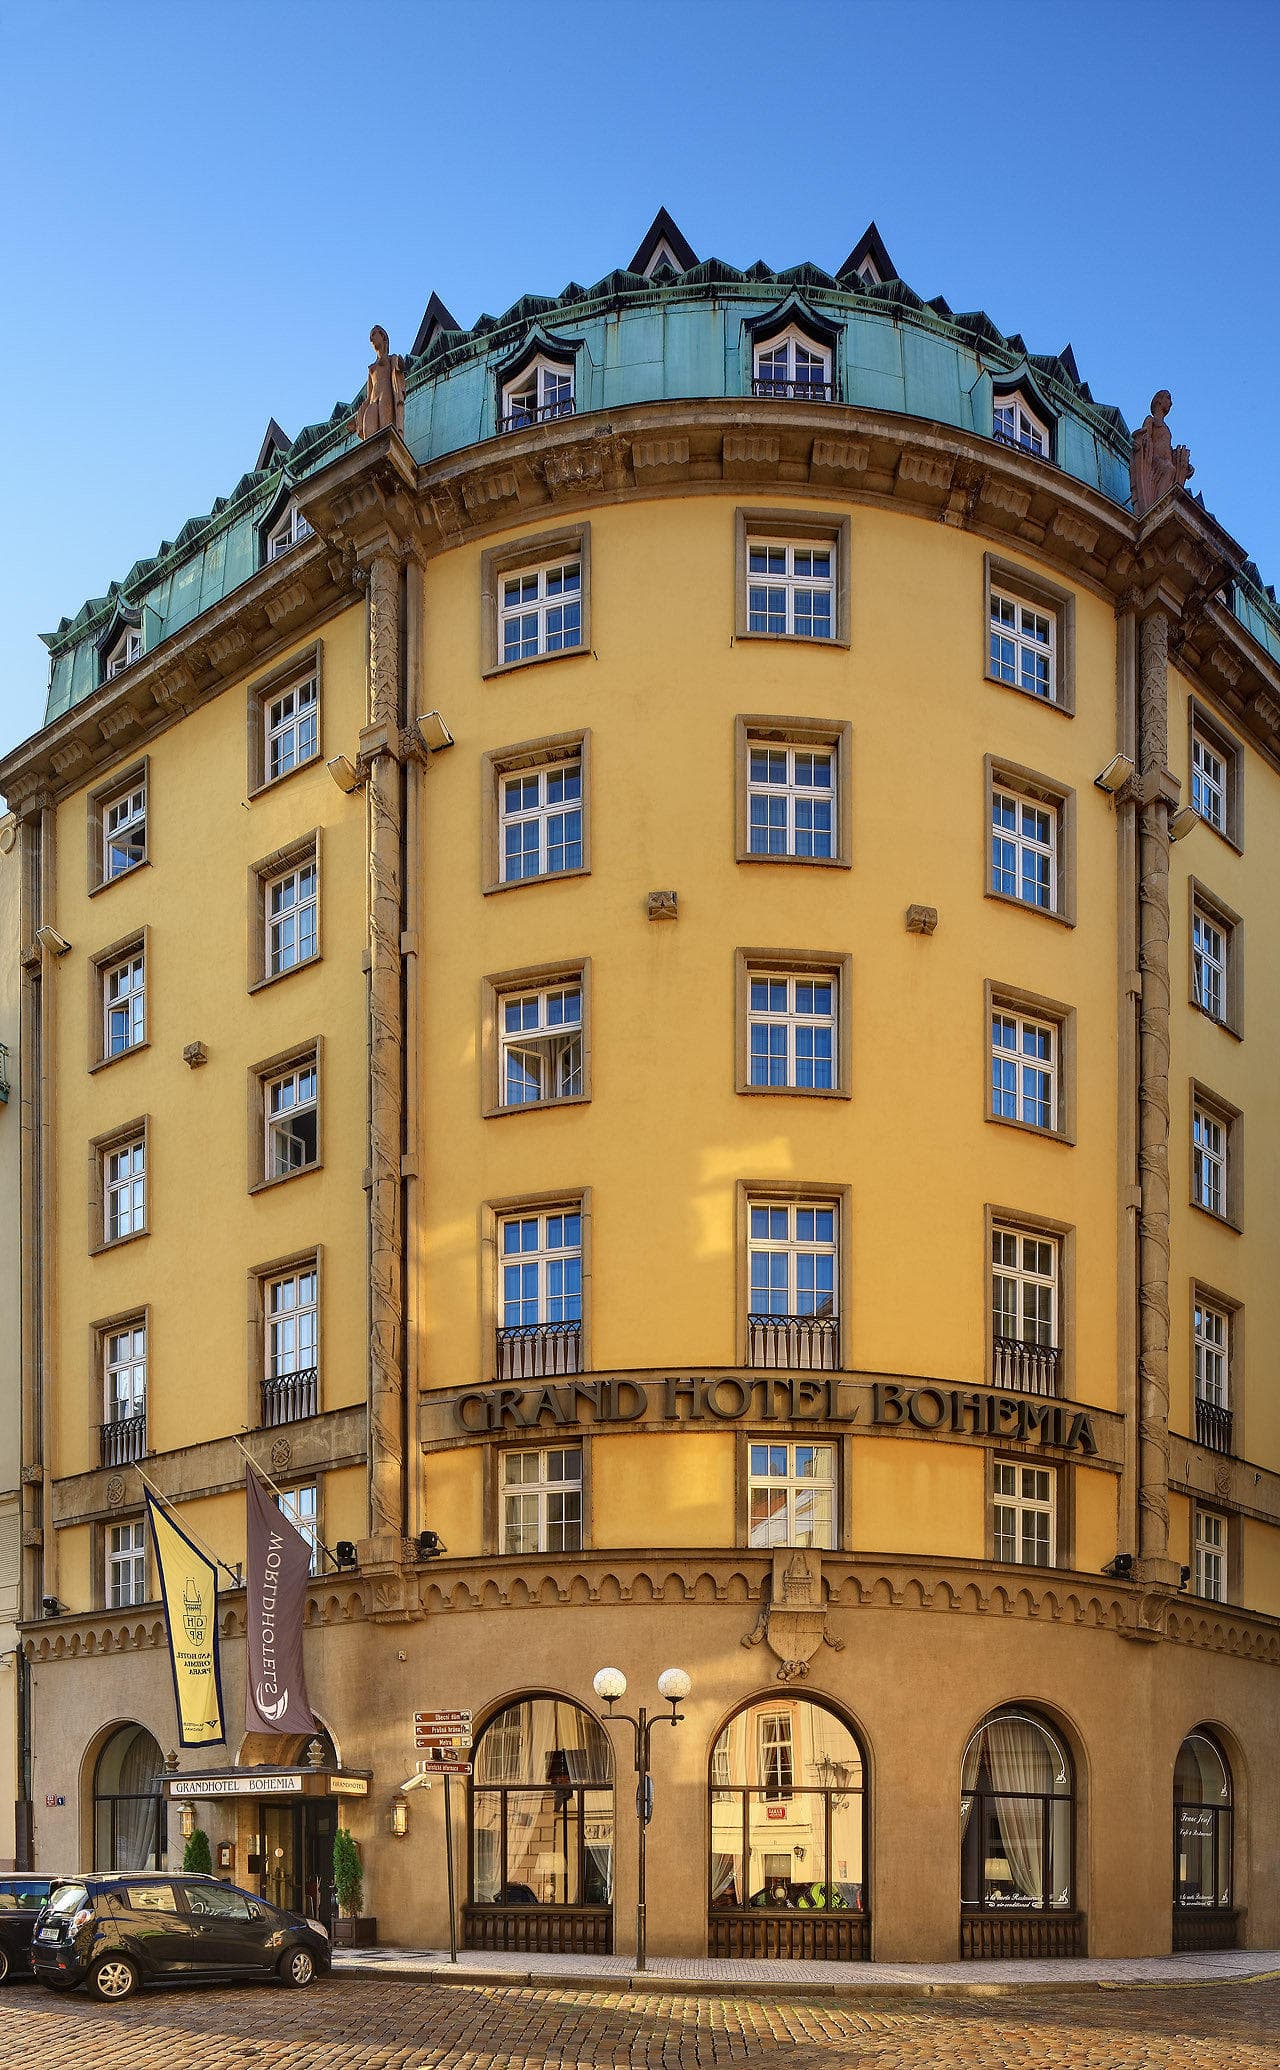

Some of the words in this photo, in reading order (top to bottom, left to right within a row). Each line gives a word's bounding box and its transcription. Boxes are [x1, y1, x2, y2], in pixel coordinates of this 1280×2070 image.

[452, 1378, 648, 1432] GRAND
[664, 1376, 860, 1424] HOTEL
[872, 1382, 1099, 1455] BOHEMIA
[176, 1780, 240, 1793] GRANDHOTEL
[249, 1778, 295, 1790] BOHEMIA
